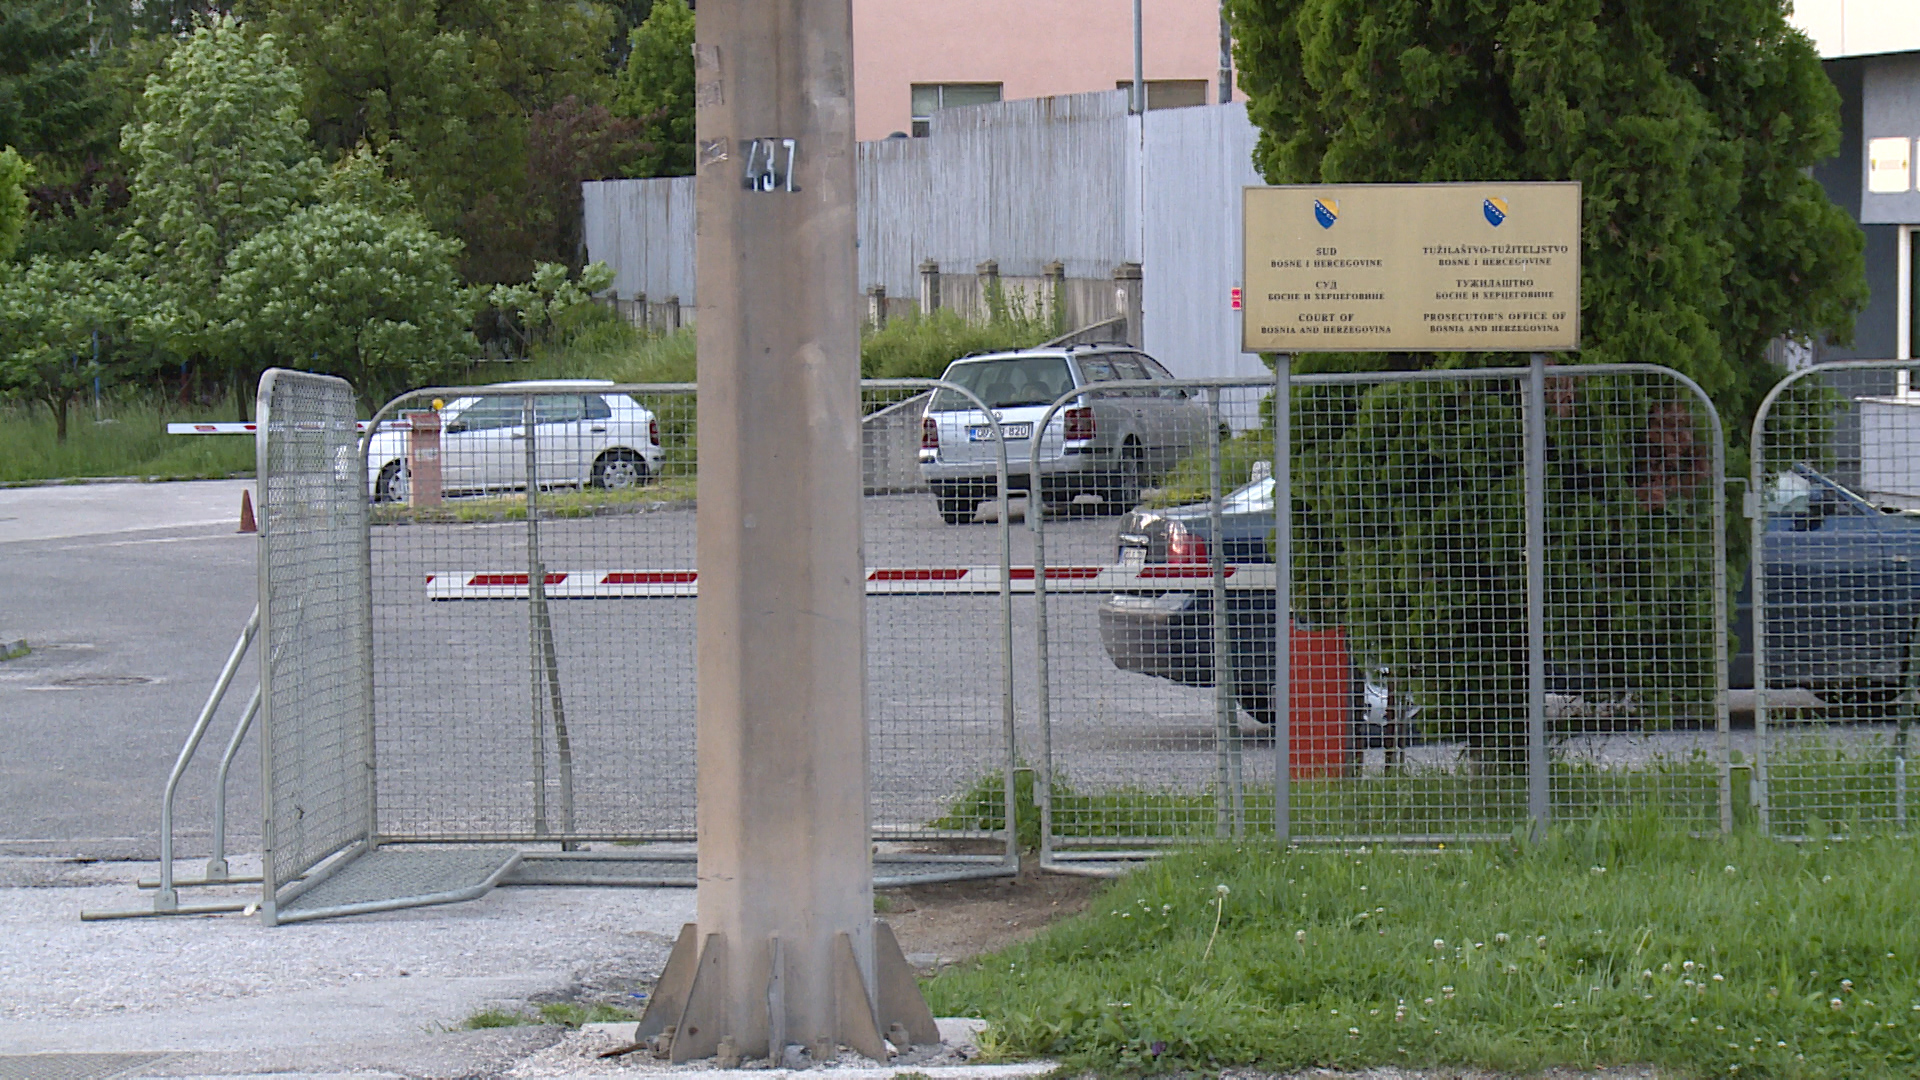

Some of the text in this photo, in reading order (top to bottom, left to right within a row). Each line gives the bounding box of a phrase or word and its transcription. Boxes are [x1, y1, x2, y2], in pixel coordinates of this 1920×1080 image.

[745, 139, 796, 193] 437
[1316, 247, 1337, 256] SUD
[1271, 260, 1302, 268] BOSNE
[1438, 258, 1470, 266] BOSNE
[1316, 281, 1337, 290] СУД
[1298, 313, 1335, 322] COURT
[1424, 312, 1566, 322] PROSECUTOR'S OFFICE OF
[1261, 326, 1391, 334] BOSNIA AND HERZEGOVINA
